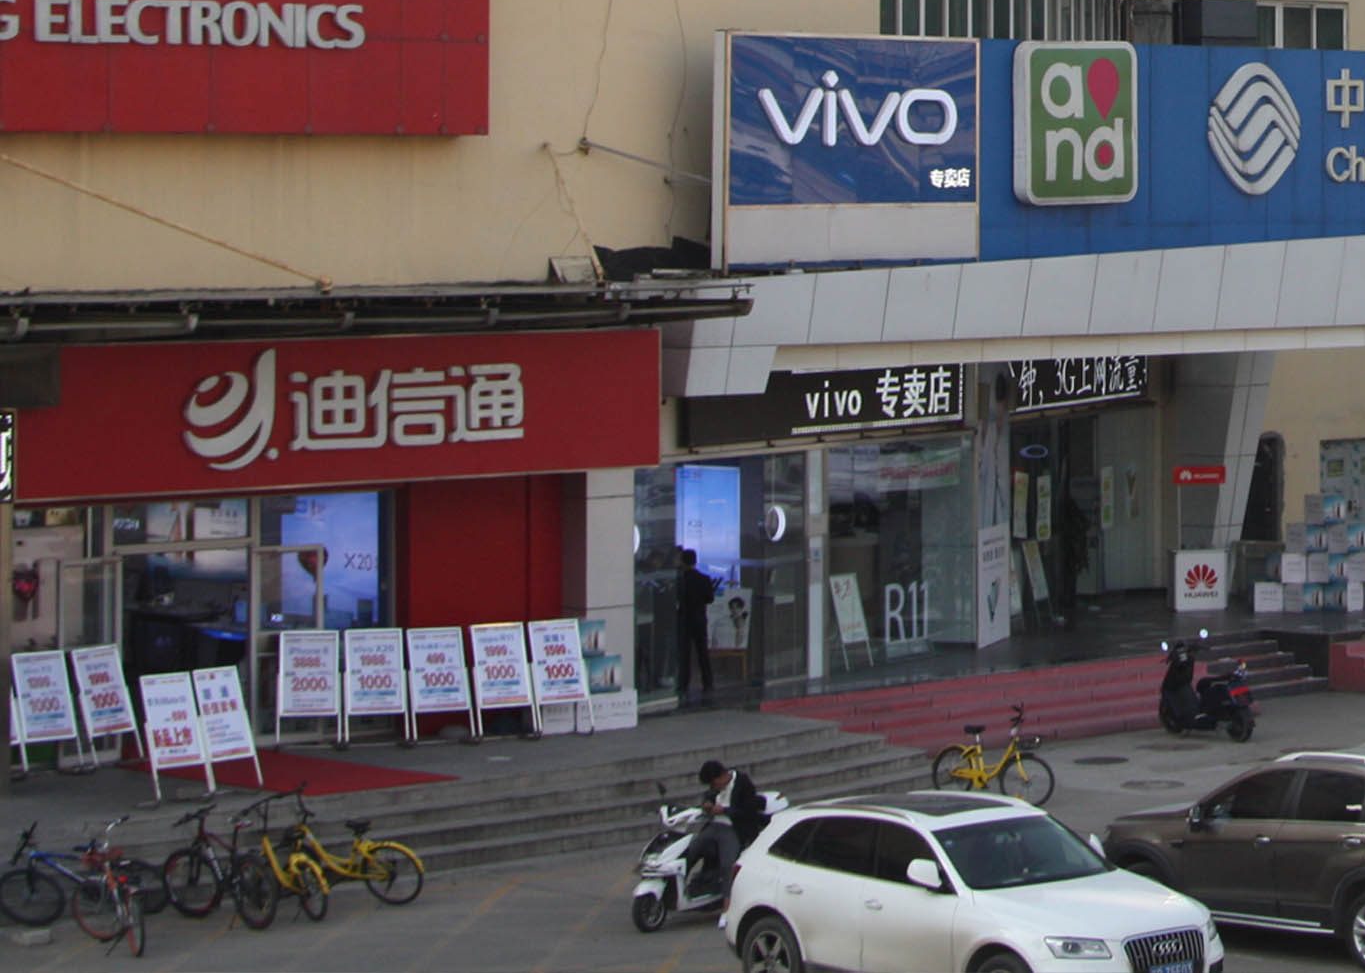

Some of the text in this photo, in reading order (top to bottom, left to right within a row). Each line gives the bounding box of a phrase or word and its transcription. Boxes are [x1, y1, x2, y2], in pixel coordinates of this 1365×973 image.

[759, 70, 958, 146] vivo
[930, 168, 970, 189] 专卖店
[289, 363, 524, 451] 迪信通
[805, 366, 951, 419] vivo 专卖店
[885, 580, 929, 644] R11
